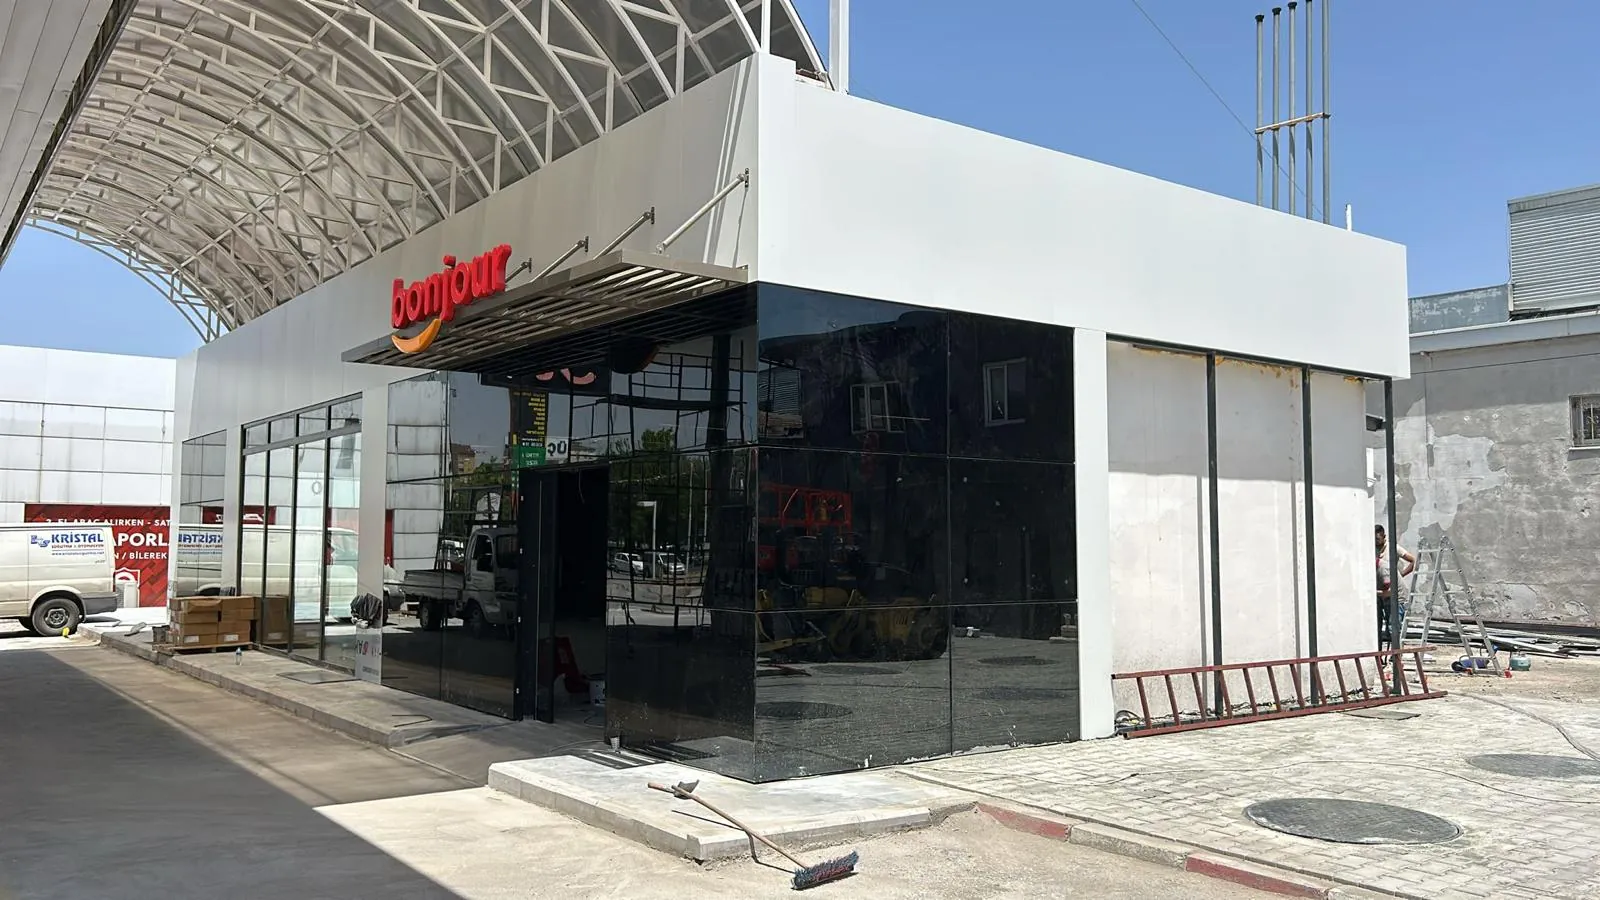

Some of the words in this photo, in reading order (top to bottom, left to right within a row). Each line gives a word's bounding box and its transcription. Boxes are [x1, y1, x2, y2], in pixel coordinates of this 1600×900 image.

[391, 243, 512, 329] bonjour
[104, 518, 144, 526] ALIRKEN
[51, 532, 104, 543] KRİSTAL
[113, 532, 170, 547] PORL
[129, 550, 168, 559] BİLEREK
